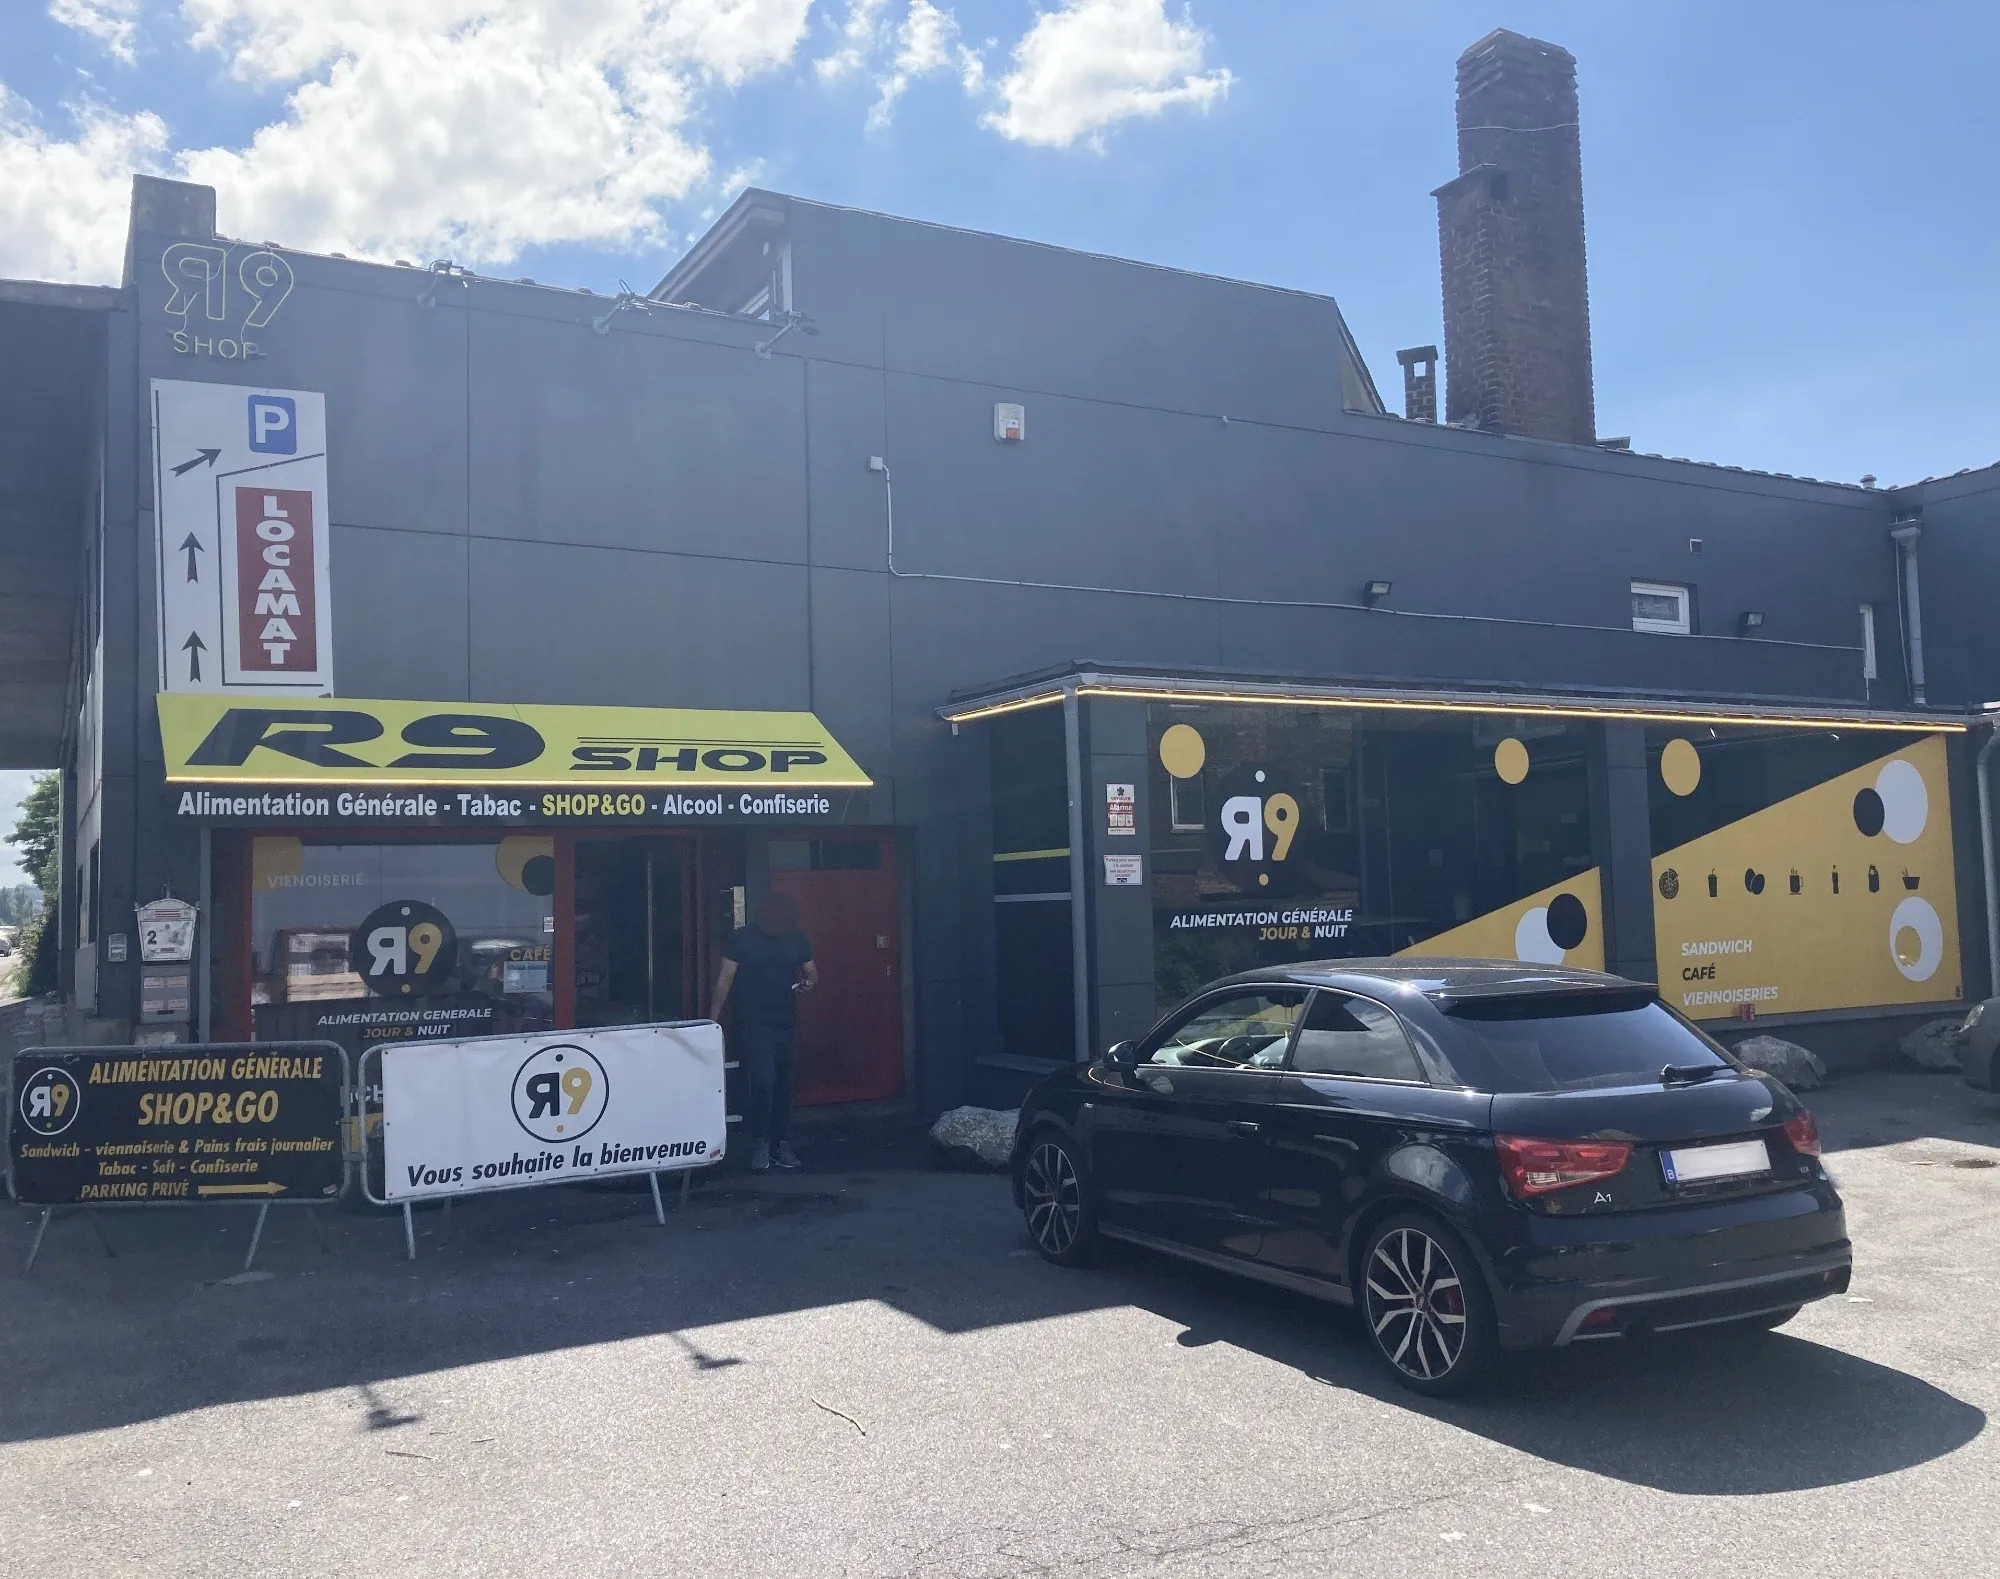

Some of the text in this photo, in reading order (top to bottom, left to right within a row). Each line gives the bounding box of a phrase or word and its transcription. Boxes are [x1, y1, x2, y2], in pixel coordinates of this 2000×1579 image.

[173, 331, 259, 359] SHOP
[254, 404, 290, 443] P
[254, 495, 301, 664] LOCAMAT
[185, 708, 829, 772] R9 SHOP
[177, 791, 329, 816] Alimentation
[336, 793, 437, 816] Générale
[457, 794, 521, 816] Tabac
[542, 794, 646, 816] SHOP&GO
[664, 795, 723, 815] Alcool
[740, 794, 830, 814] Confiserie
[1109, 804, 1132, 812] Alarme
[268, 873, 364, 888] VIENOISERIE
[1170, 908, 1352, 928] ALIMENTATION GÉNÉRALE
[147, 930, 157, 945] 2
[1259, 924, 1347, 940] JOUR & NUIT
[509, 945, 552, 961] CAFÉ
[1681, 940, 1752, 956] SANDWICH
[1682, 963, 1716, 981] CAFÉ
[1683, 987, 1778, 1006] VIENNOISERIES
[317, 1008, 492, 1026] ALIMENTATION GENERALE
[363, 1024, 450, 1039] JOUR & NUIT
[88, 1052, 323, 1084] ALIMENTATION GÉNÉRALE
[137, 1089, 279, 1126] SHOP&GO
[20, 1143, 79, 1159] Sandwich
[95, 1140, 174, 1156] viennoiserie
[178, 1141, 189, 1153] &
[194, 1139, 229, 1154] Pains
[234, 1137, 267, 1152] frais
[270, 1138, 334, 1156] journalier
[98, 1162, 136, 1176] Tabac
[152, 1161, 174, 1174] Soft
[190, 1159, 258, 1175] Confiserie
[407, 1139, 707, 1187] Vous souhaite la bienvenue
[1667, 1169, 1675, 1180] B
[80, 1178, 189, 1200] PARKING PRIVÉ
[1594, 1191, 1613, 1204] A1
